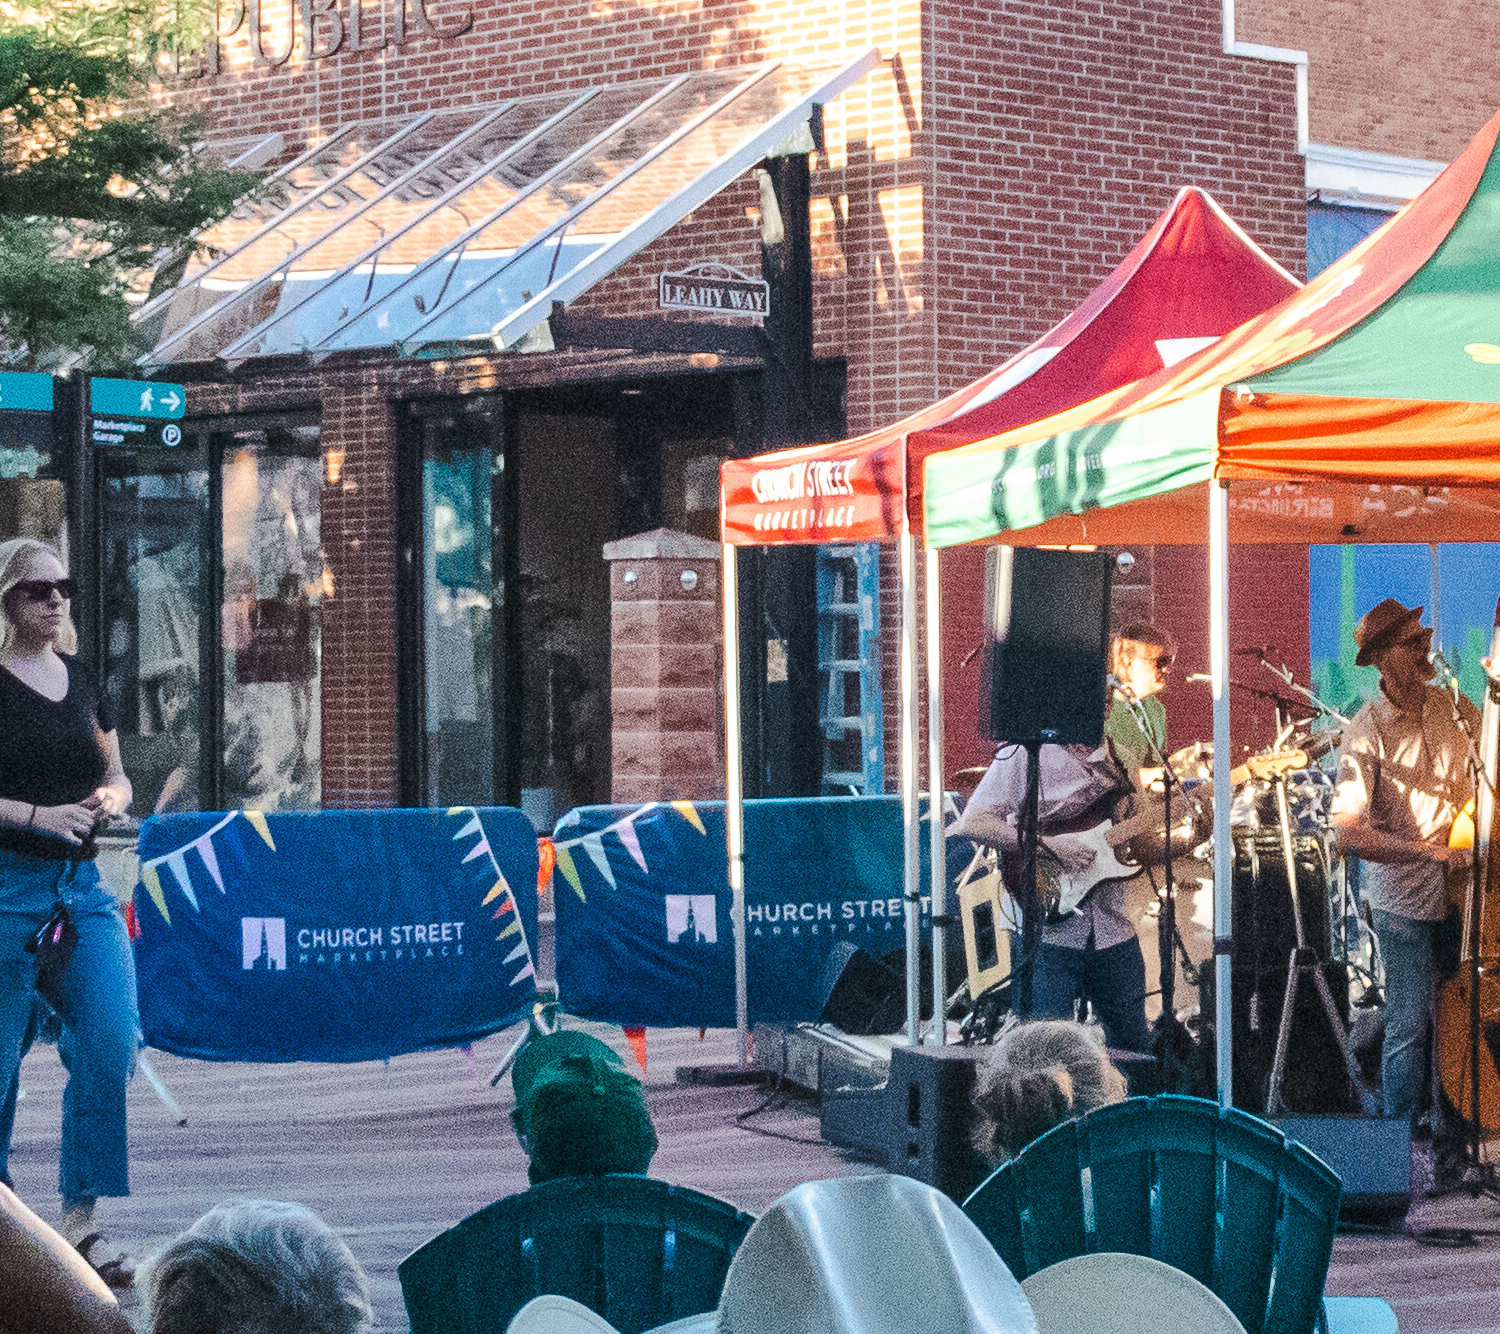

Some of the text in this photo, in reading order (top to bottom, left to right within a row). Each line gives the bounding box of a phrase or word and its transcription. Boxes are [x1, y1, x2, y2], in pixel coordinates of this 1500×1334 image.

[664, 283, 765, 311] LEAHY WAY
[751, 458, 858, 503] CHURCH STREET
[753, 504, 856, 531] MARKETPLACE
[729, 896, 932, 924] HURCH STRET
[296, 920, 466, 949] CHURCH STREET
[298, 943, 465, 964] MARKETPLACE
